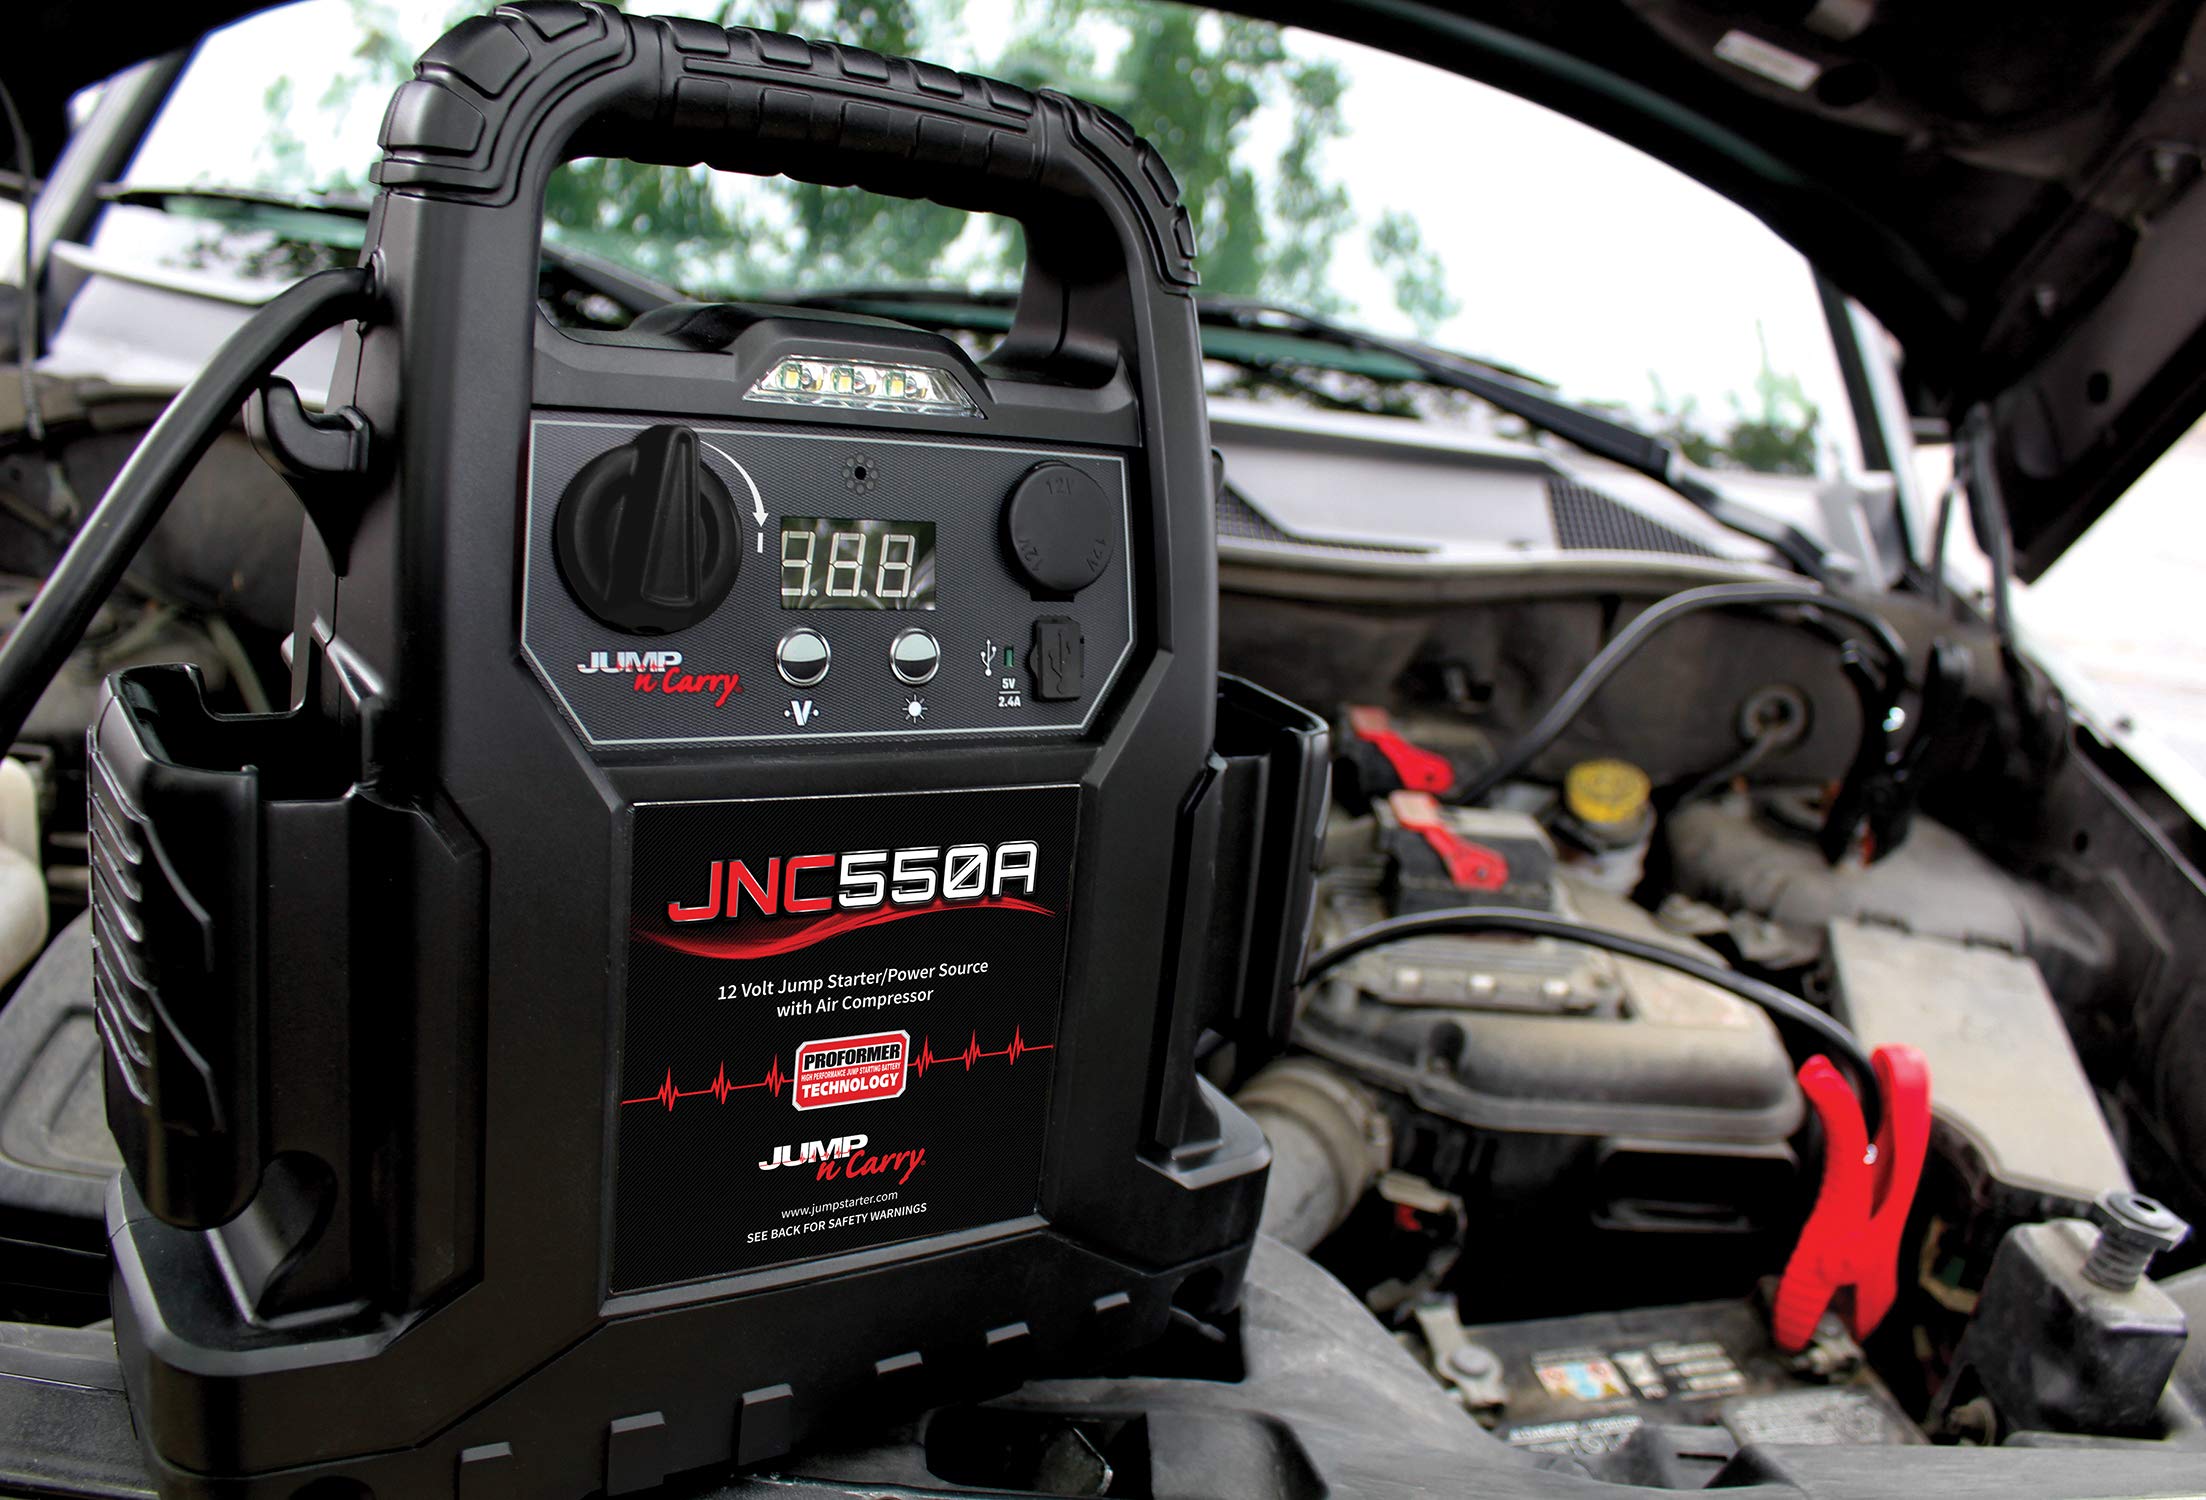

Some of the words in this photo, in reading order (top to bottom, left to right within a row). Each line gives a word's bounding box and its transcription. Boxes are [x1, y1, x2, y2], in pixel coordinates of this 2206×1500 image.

[577, 651, 683, 674] JUMP
[633, 673, 658, 692] n
[1002, 678, 1016, 690] 5V
[998, 696, 1021, 708] 2.4A
[668, 839, 1040, 922] JNC550A
[717, 984, 738, 1000] 12
[741, 979, 774, 998] Volt
[777, 977, 824, 995] Jump
[827, 965, 936, 988] Starter/Power
[938, 961, 989, 977] Source
[776, 1000, 812, 1018] with
[815, 996, 839, 1013] Air
[842, 987, 934, 1010] Compressor
[803, 1043, 901, 1071] PROFORMER
[801, 1073, 813, 1082] HIGH
[813, 1068, 846, 1080] PERFORMANCE
[846, 1066, 859, 1076] JUMP
[859, 1064, 881, 1075] STARTING
[881, 1062, 901, 1072] BATTERY
[801, 1072, 900, 1098] TECHNOLOGY
[758, 1133, 869, 1171] JUMP
[815, 1159, 842, 1181] n
[781, 1191, 898, 1219] www.jumpstarter.com
[746, 1230, 768, 1243] SEE
[770, 1224, 801, 1240] BACK
[803, 1220, 826, 1235] FOR
[828, 1212, 869, 1229] SAFETY
[870, 1202, 927, 1222] WARNINGS
